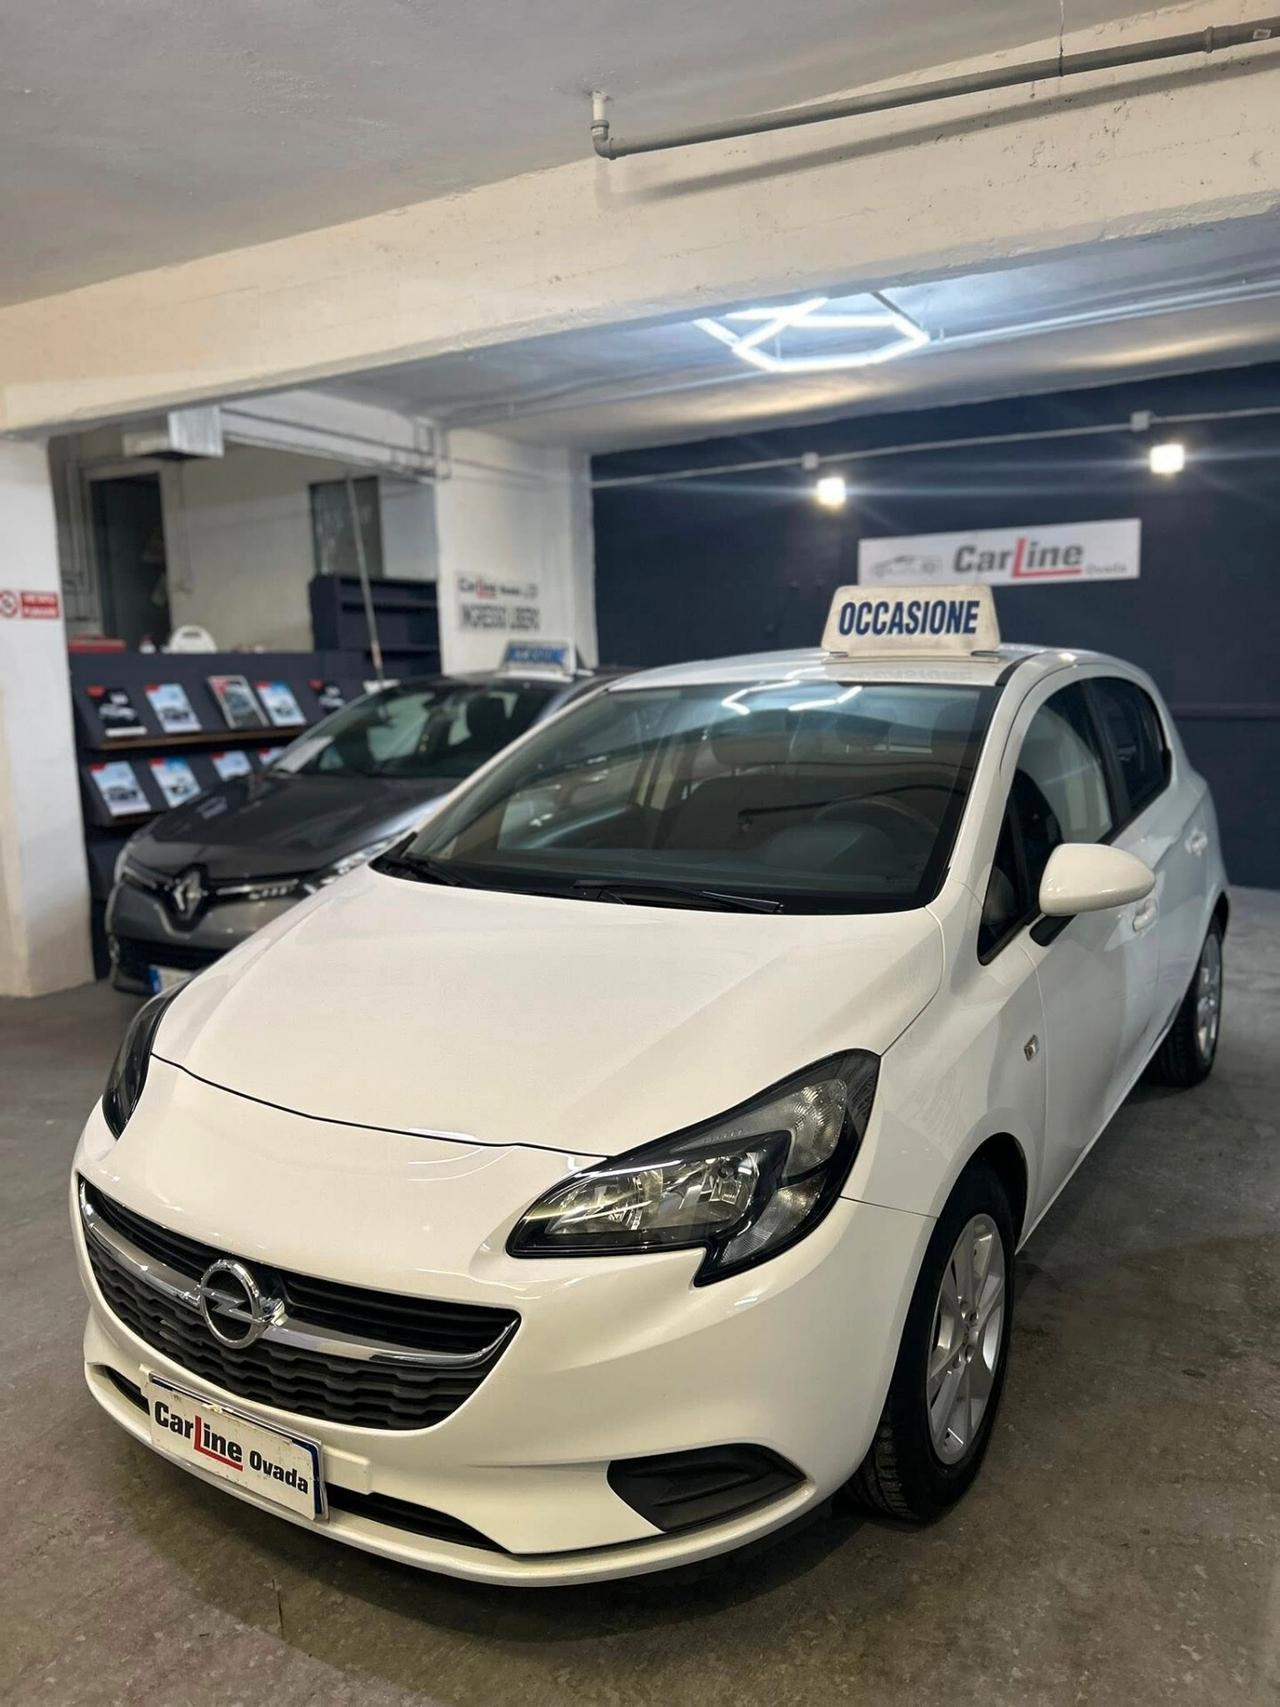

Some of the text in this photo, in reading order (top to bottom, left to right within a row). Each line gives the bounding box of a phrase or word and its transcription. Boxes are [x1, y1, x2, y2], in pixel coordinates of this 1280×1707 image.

[953, 536, 1084, 579] CarLine
[839, 600, 980, 635] OCCASIONE
[154, 1401, 309, 1494] CarLine Ovada
